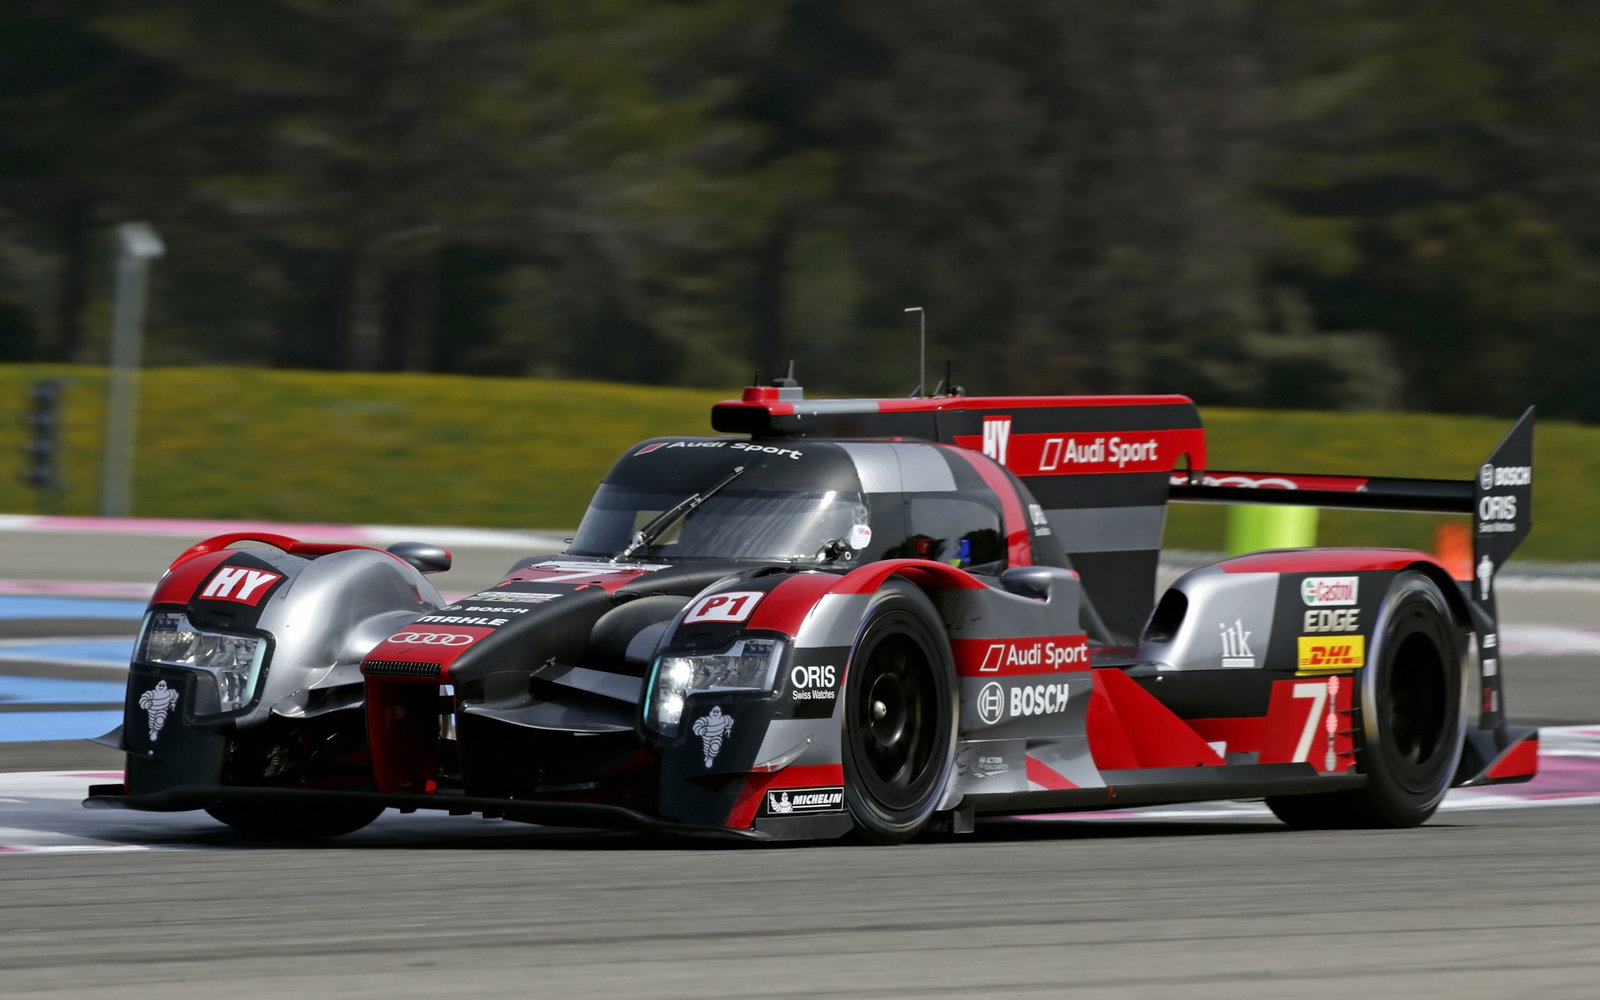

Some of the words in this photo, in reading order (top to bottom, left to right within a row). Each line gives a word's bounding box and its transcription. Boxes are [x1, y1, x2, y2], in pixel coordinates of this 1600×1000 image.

[667, 441, 727, 449] Audi
[730, 442, 803, 460] Sport
[982, 420, 1011, 465] HY
[1063, 437, 1105, 463] Audi
[1108, 436, 1158, 468] Sport
[202, 568, 277, 600] HY
[1317, 581, 1354, 601] Castrol
[465, 606, 530, 614] BOSCH
[696, 595, 749, 617] P1
[416, 615, 509, 626] MAHLE
[1303, 609, 1361, 633] EDGE
[1219, 617, 1255, 657] itk
[1006, 643, 1041, 666] Audi
[1045, 642, 1088, 669] Sport
[1310, 646, 1354, 665] DHL
[791, 665, 835, 689] ORIS
[792, 690, 811, 700] Swiss
[812, 690, 835, 699] Watches
[1010, 684, 1069, 717] BOSCH
[1291, 682, 1328, 763] 7
[792, 793, 842, 805] MICHELIN
